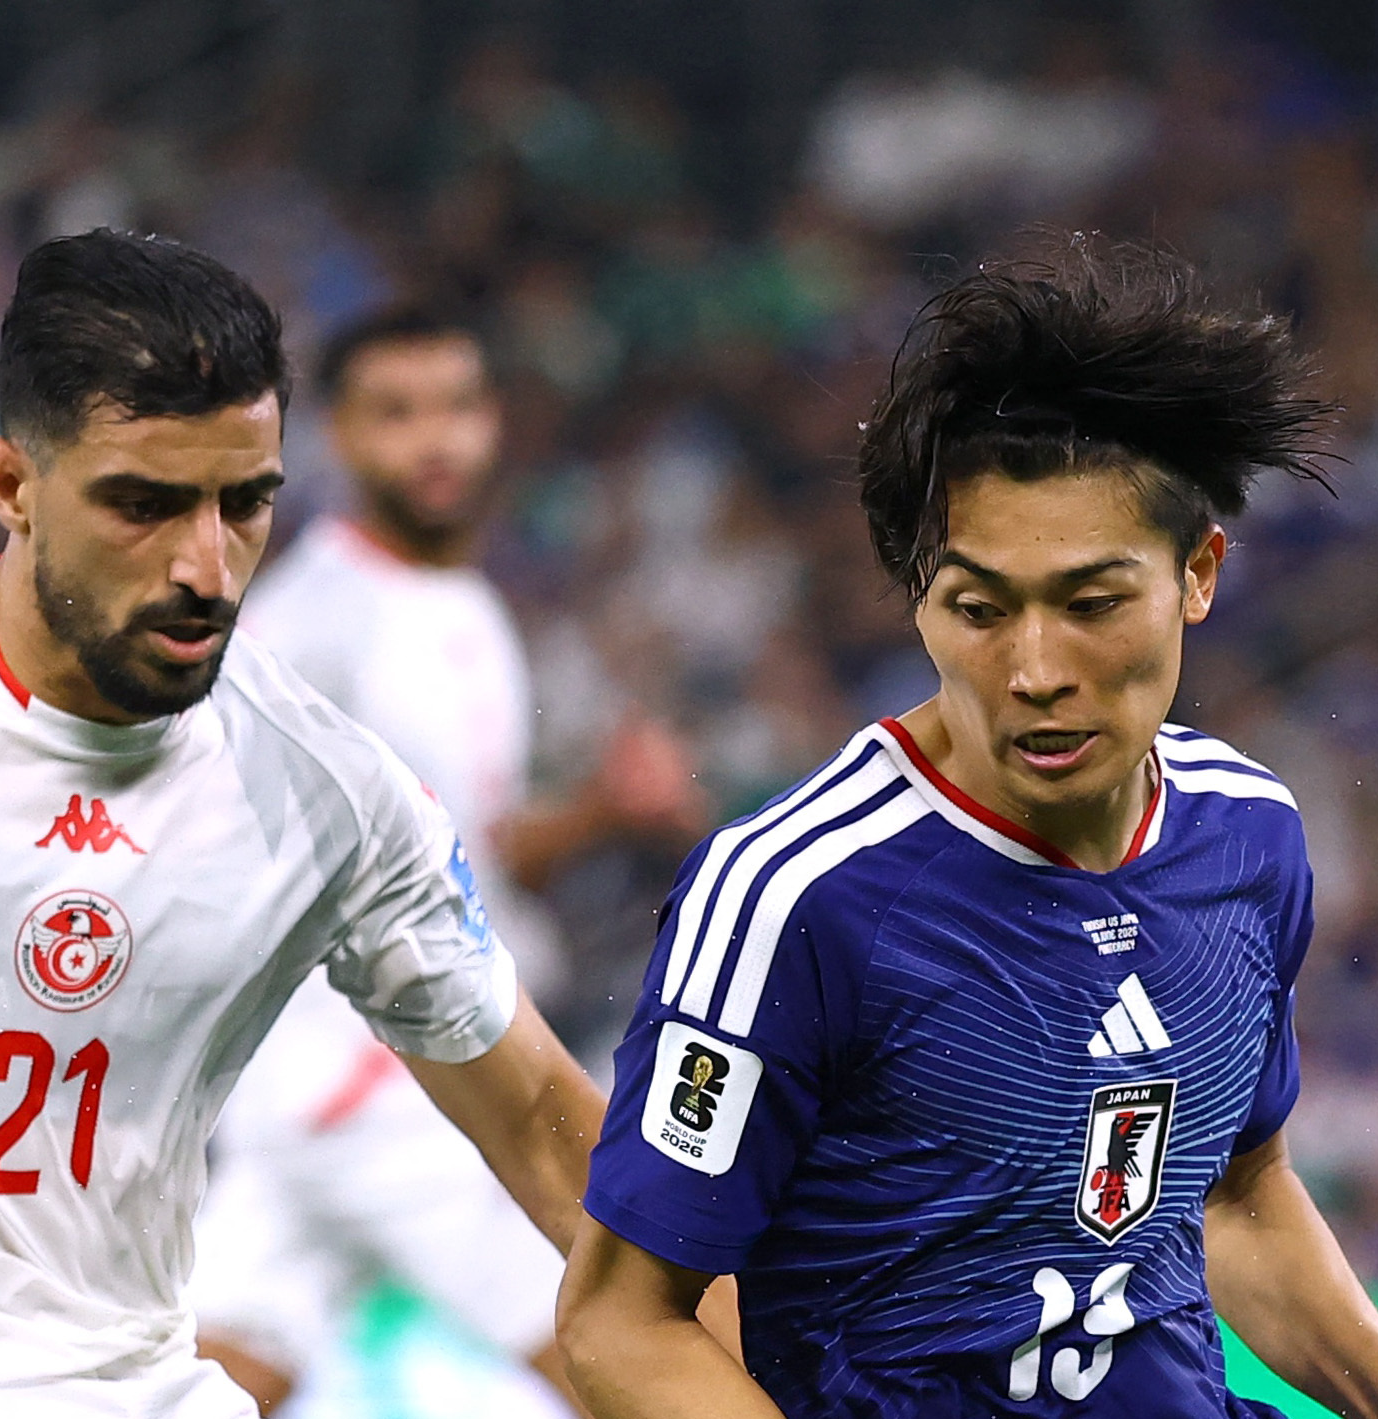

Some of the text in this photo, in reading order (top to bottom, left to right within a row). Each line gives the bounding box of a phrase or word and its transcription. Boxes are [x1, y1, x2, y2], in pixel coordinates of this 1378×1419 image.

[1117, 925, 1139, 940] 2026
[1106, 1088, 1152, 1105] JAPAN
[678, 1105, 699, 1125] FIFA
[660, 1127, 704, 1159] 2026
[664, 1118, 707, 1146] WORLD CUP
[1091, 1187, 1132, 1215] JFA
